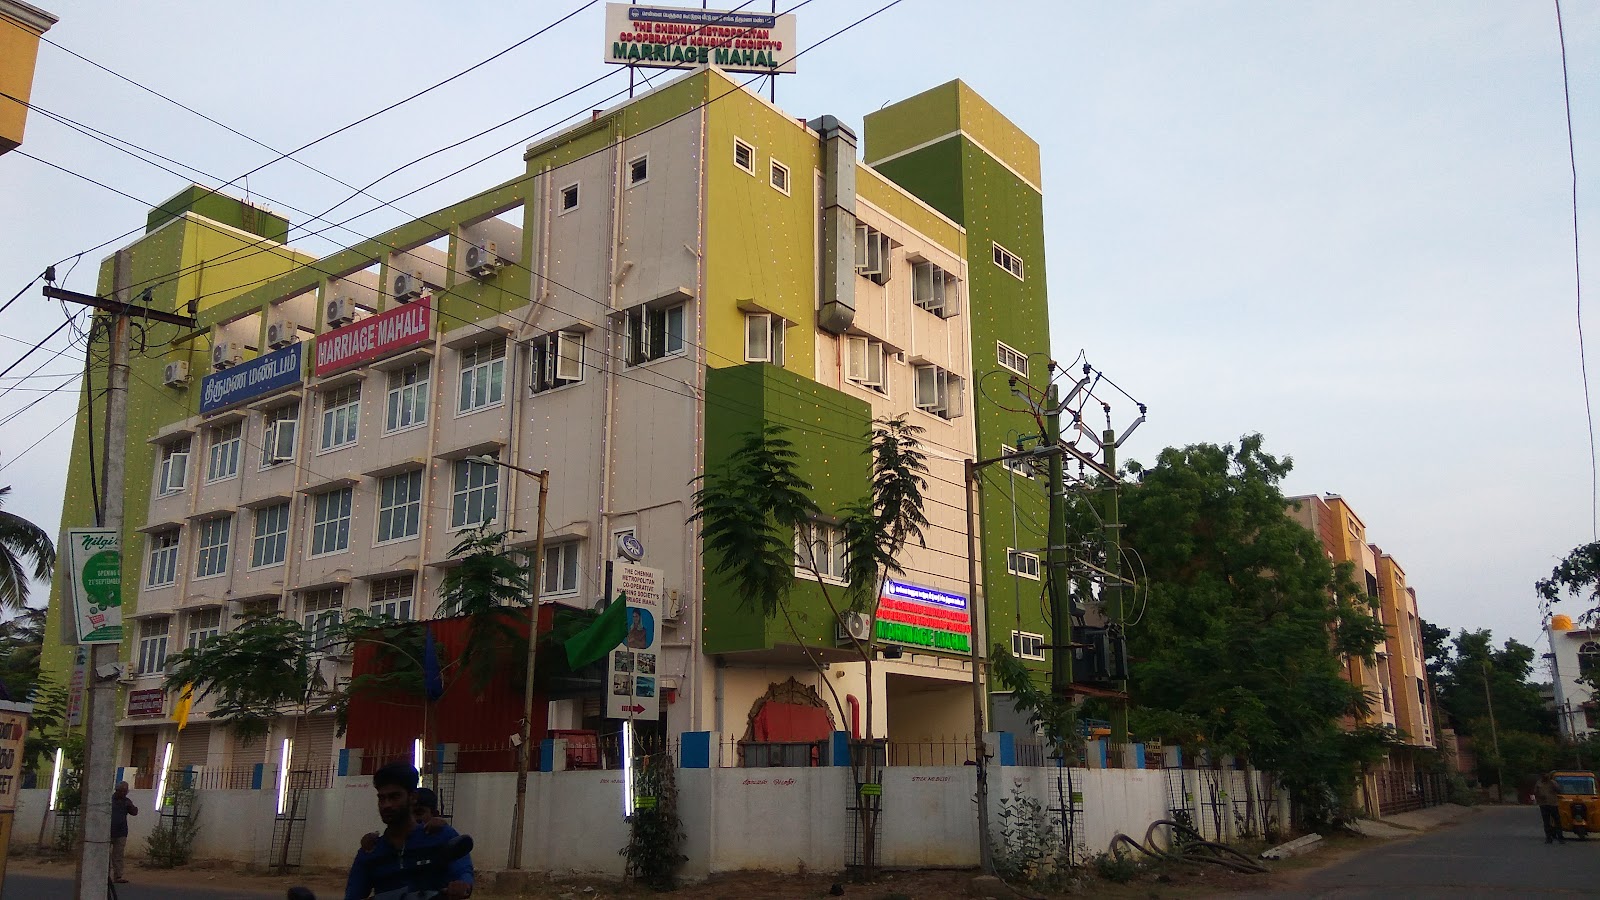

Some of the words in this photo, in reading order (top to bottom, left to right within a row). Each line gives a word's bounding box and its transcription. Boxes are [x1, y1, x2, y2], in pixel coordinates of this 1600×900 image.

[633, 22, 652, 32] THE
[654, 23, 696, 36] CHENNAI
[699, 25, 769, 39] METROPOLITAN
[620, 32, 687, 46] CO-OPERATIVE
[690, 36, 732, 48] HOUSING
[735, 39, 783, 51] SOCIETY'S
[613, 42, 709, 63] MARRIAGE
[715, 48, 778, 67] MAHAL
[317, 323, 376, 367] MARRIAGE
[377, 305, 426, 345] MAHALL
[203, 370, 248, 407] திருமண
[249, 349, 297, 386] மண்டபம்
[622, 575, 655, 585] METROPOLITAN
[634, 570, 654, 578] CHENNAI
[623, 582, 654, 592] CO-OPERATIVE
[638, 591, 660, 600] SOCIETY'S
[876, 620, 933, 647] MARRIAGE
